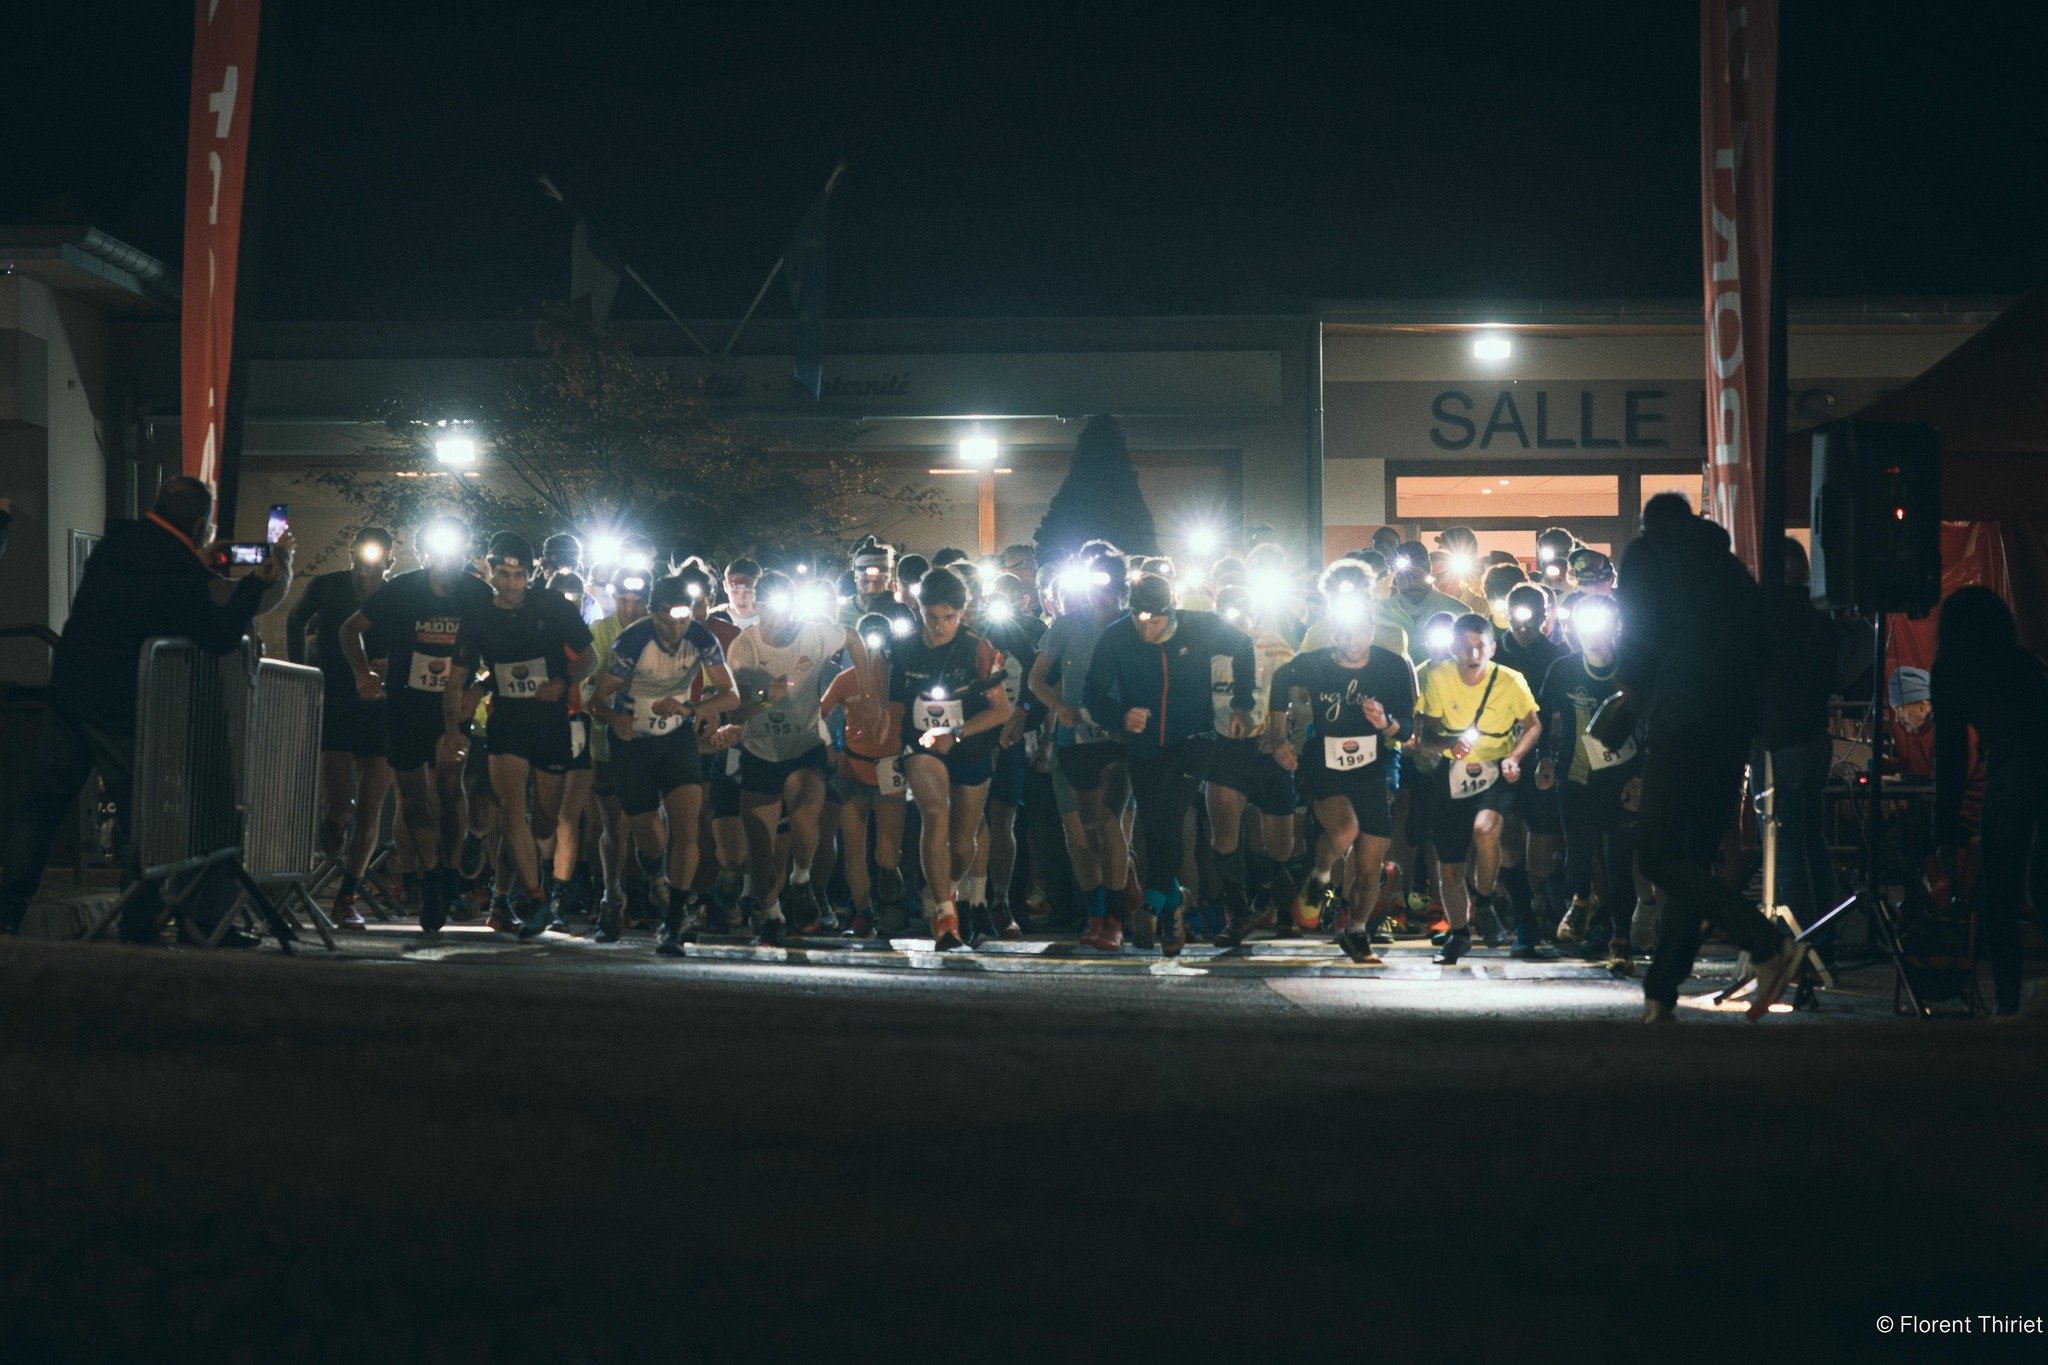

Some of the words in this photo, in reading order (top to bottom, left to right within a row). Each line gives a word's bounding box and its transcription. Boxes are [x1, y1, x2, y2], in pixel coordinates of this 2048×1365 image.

[1429, 391, 1669, 449] SALLE
[420, 674, 448, 688] 135
[1336, 754, 1365, 767] 199
